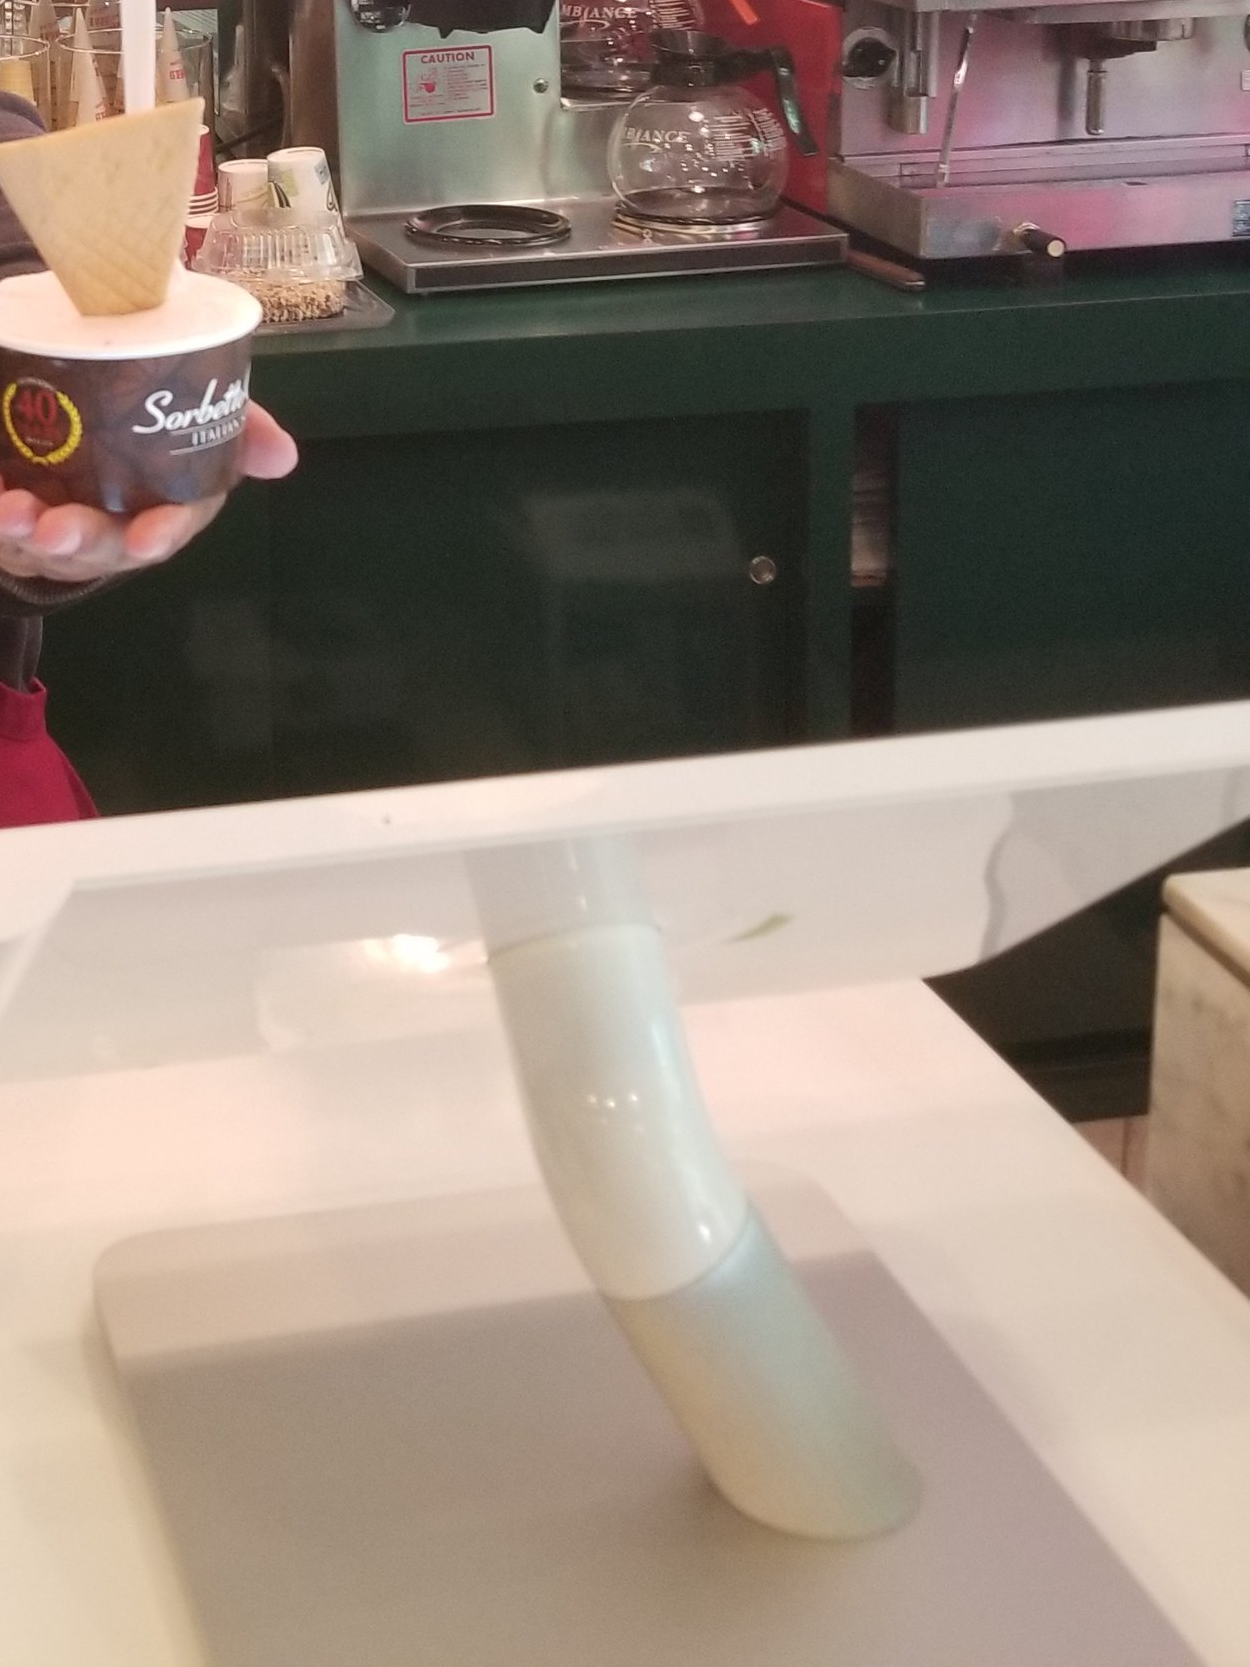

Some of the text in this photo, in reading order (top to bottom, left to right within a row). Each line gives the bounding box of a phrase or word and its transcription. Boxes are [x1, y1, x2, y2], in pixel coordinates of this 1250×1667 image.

[562, 5, 638, 20] MBIANCE
[421, 52, 474, 63] CAUTION
[624, 127, 689, 143] BIANCE
